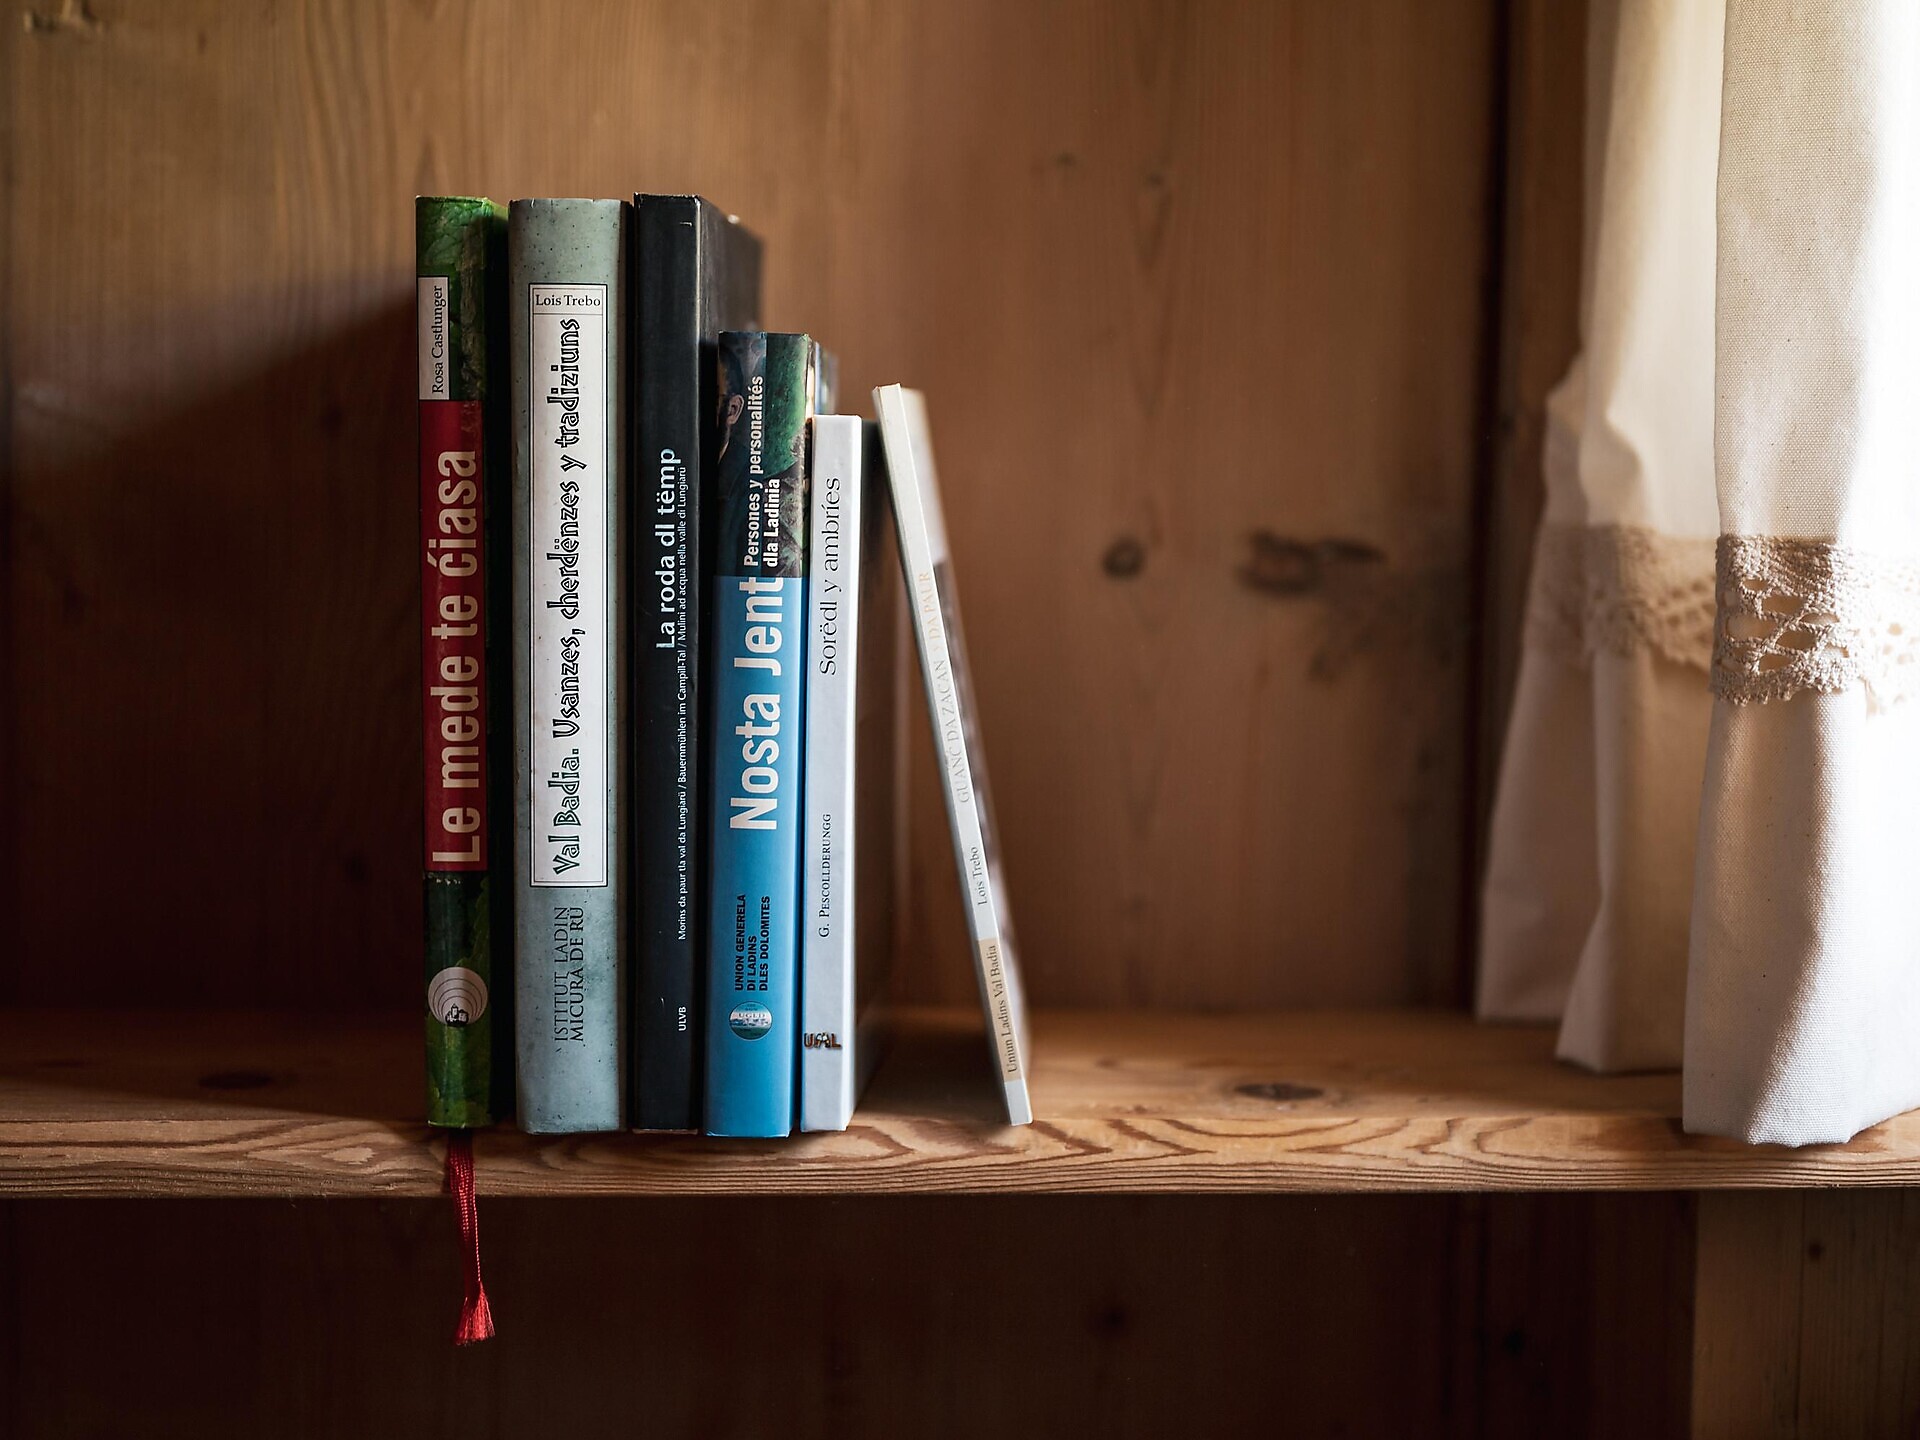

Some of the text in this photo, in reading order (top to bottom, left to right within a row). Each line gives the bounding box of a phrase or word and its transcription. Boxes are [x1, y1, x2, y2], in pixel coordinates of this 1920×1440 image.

[535, 294, 601, 307] Lois Trebo
[431, 285, 446, 394] Rosa Castlunger
[743, 375, 764, 567] Persones y personalités
[677, 467, 689, 507] Lungiarü
[677, 509, 686, 519] di
[763, 479, 780, 568] dla Ladinia
[677, 520, 686, 542] valle
[655, 448, 681, 648] La roda dl tëmp
[677, 544, 686, 566] nella
[679, 567, 689, 596] acqua
[818, 477, 842, 676] Sorëdl y ambríes
[918, 571, 936, 613] PAUR
[546, 319, 586, 874] Val Badia. Usanzes, cherdënzes y tradiziuns
[677, 598, 686, 610] ad
[677, 611, 686, 641] Mulini
[927, 615, 941, 640] DA
[426, 450, 481, 862] Le mede te ćiasa
[677, 649, 689, 700] Campill-Tal
[677, 702, 686, 715] im
[729, 577, 784, 830] Nosta Jent
[945, 718, 959, 741] DA
[677, 717, 687, 783] Bauernmühlen
[677, 791, 689, 830] Lungiarü
[677, 832, 686, 844] da
[677, 845, 686, 859] val
[677, 860, 686, 872] tla
[969, 846, 988, 906] Lois Trebo
[678, 873, 689, 894] paur
[677, 895, 686, 908] da
[566, 907, 584, 931] RÜ
[677, 909, 686, 940] Morins
[818, 923, 830, 938] G.
[569, 937, 584, 961] DE
[734, 894, 746, 991] UNION GENERELA
[759, 895, 770, 991] DLES DOLOMITES
[553, 907, 568, 1041] ISTITUT LADIN
[746, 935, 757, 991] DI LADINS
[678, 1006, 687, 1032] ULVB
[986, 945, 1018, 1073] Uniun Ladins Val Badia
